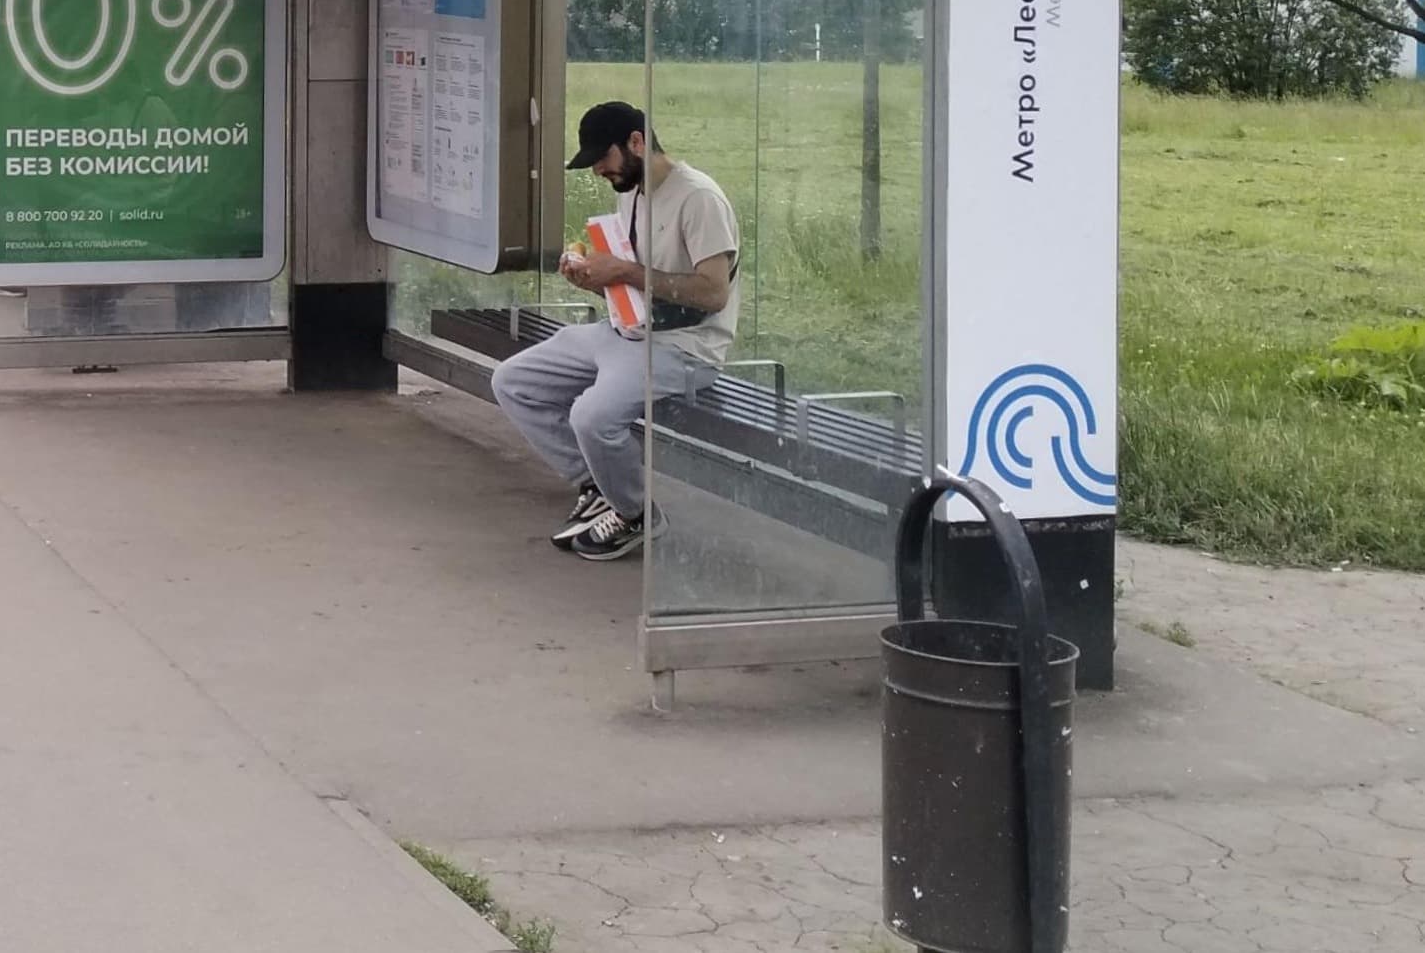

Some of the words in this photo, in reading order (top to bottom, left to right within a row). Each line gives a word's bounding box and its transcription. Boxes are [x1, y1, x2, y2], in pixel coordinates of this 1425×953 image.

[5, 127, 147, 150] ПЕРЕВОДЫ
[154, 122, 249, 150] ДОМОЙ
[1011, 74, 1039, 183] Метро
[5, 156, 52, 177] БЕЗ
[60, 155, 210, 176] КОМИССИИ!
[5, 211, 14, 222] 8
[17, 211, 41, 222] 800
[44, 210, 68, 221] 700
[119, 209, 164, 221] solid.ru
